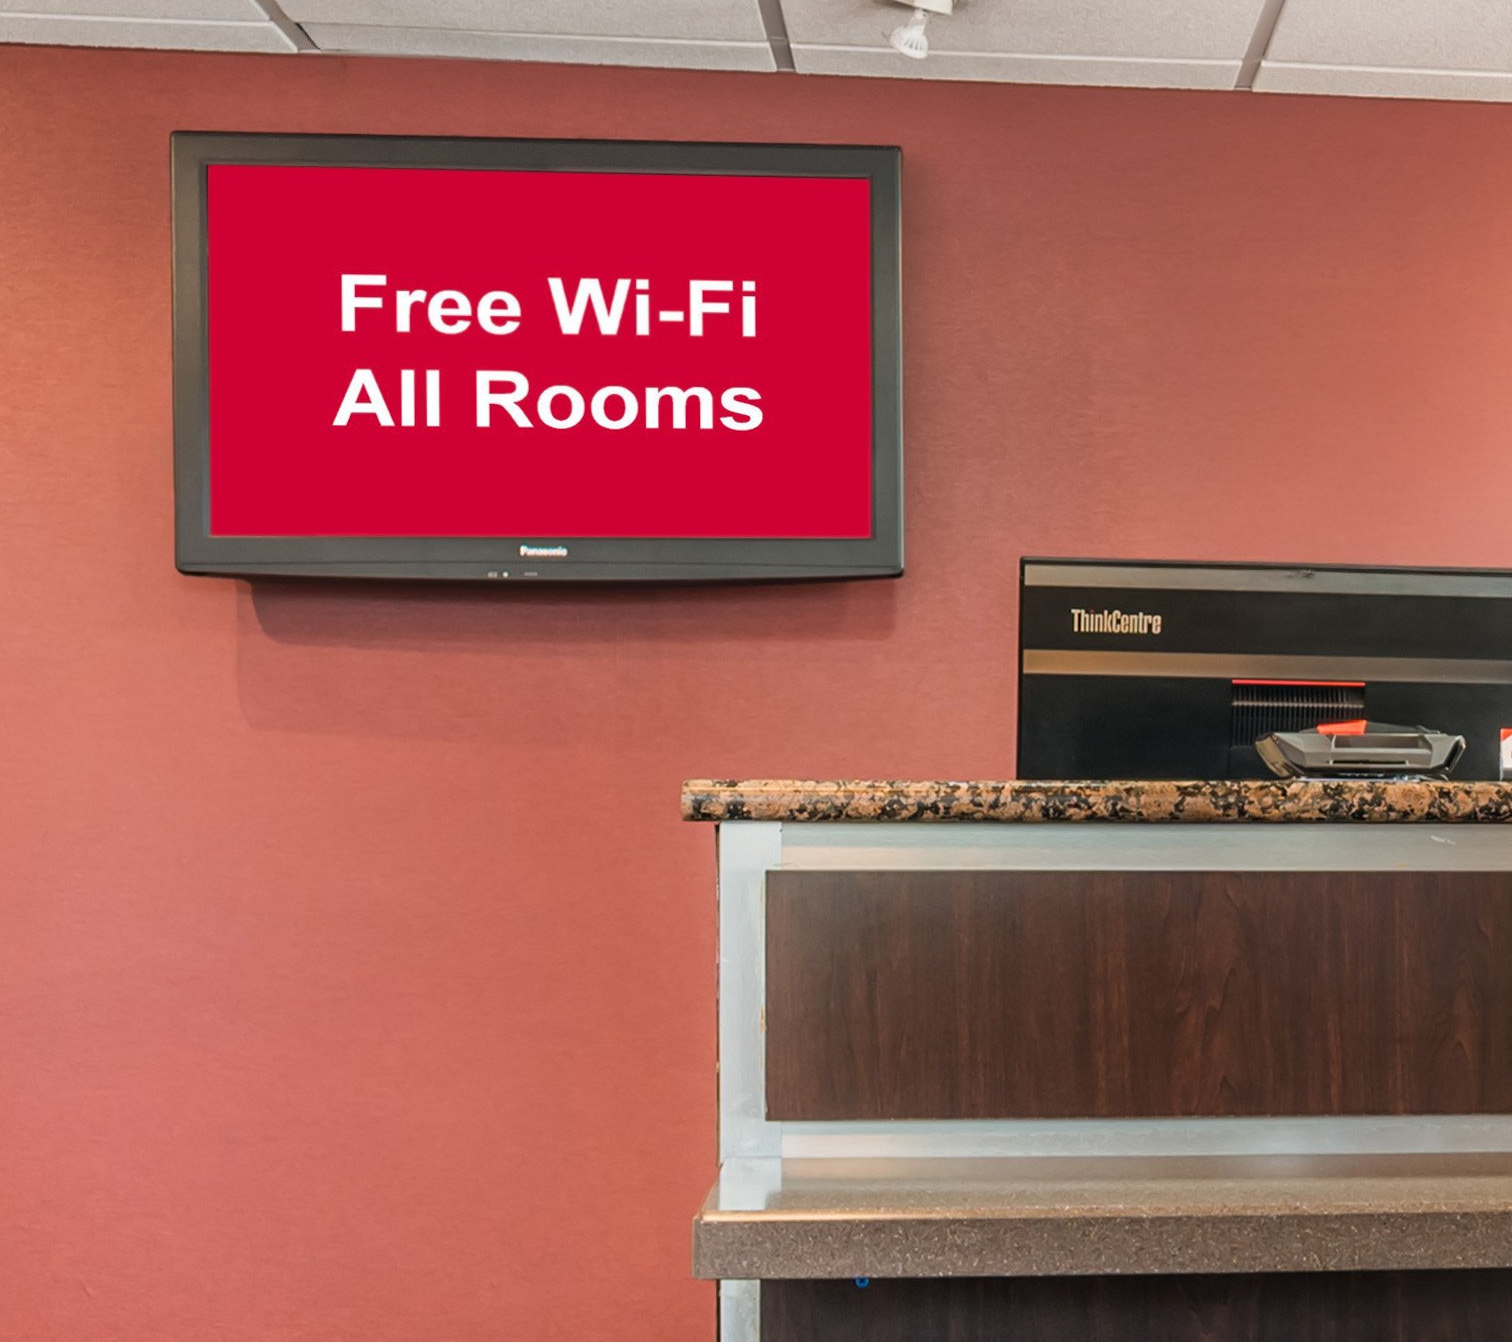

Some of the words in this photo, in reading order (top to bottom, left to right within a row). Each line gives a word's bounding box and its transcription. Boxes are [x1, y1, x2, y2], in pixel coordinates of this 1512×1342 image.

[341, 273, 522, 336] Free
[547, 277, 757, 338] Wi-Fi
[332, 368, 441, 427] All
[475, 369, 764, 431] Rooms
[1070, 608, 1162, 635] ThinkCentre
